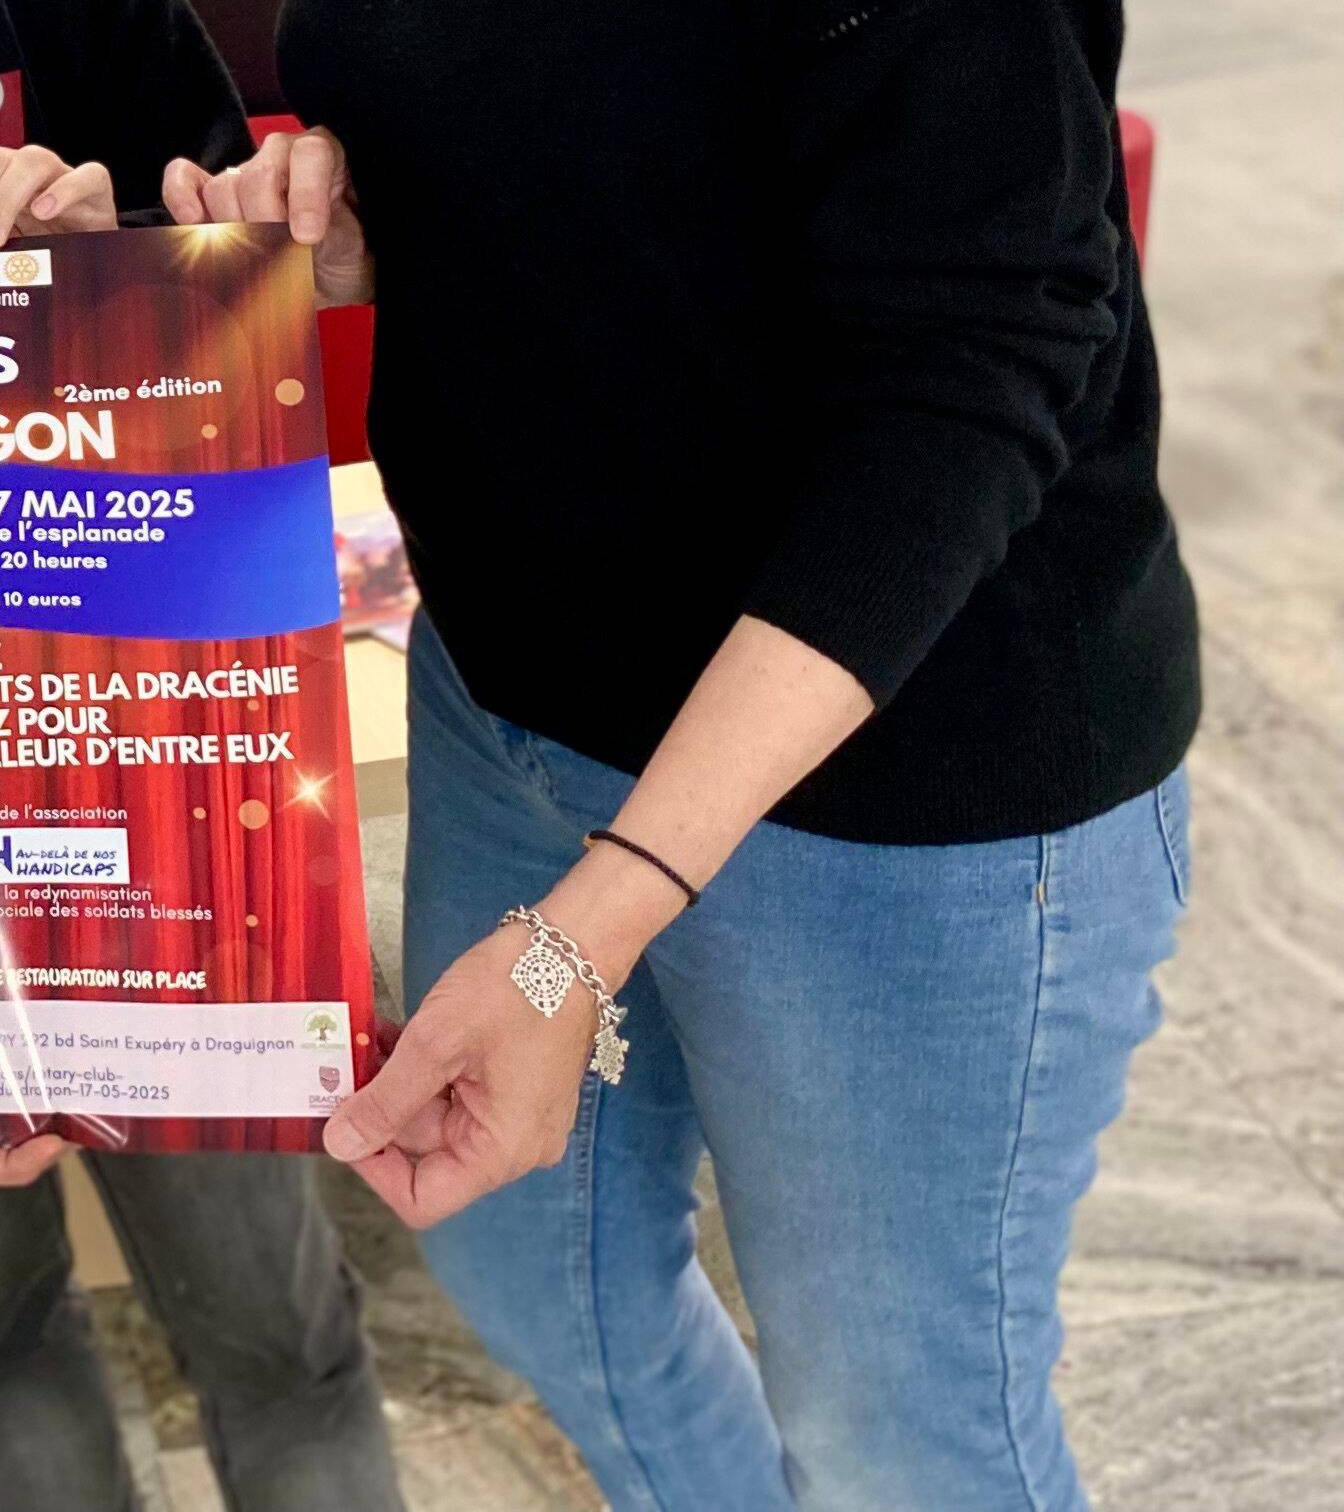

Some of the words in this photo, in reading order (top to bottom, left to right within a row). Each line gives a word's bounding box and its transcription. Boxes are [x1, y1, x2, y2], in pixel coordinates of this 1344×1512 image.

[64, 383, 130, 404] 2ème
[136, 376, 222, 399] édition
[22, 491, 95, 518] MAI
[105, 489, 194, 518] 2025
[0, 552, 28, 570] 20
[33, 551, 107, 569] heures
[3, 592, 22, 607] 10
[28, 593, 82, 607] euros
[41, 673, 82, 701] DE
[89, 672, 131, 700] LA
[137, 661, 299, 700] DRACÉNIE
[17, 706, 112, 735] POUR
[227, 732, 295, 763] EUX
[0, 805, 19, 820] de
[75, 849, 88, 859] DE
[93, 850, 116, 858] NOS
[17, 863, 117, 876] HANDICAPS
[5, 886, 19, 900] la
[24, 884, 151, 904] redynamisation
[49, 903, 78, 918] des
[84, 903, 145, 919] soldats
[150, 903, 212, 920] blessés
[122, 970, 153, 988] SUR
[157, 971, 206, 989] PLACE
[55, 1034, 74, 1048] bd
[80, 1034, 118, 1049] Saint
[125, 1037, 185, 1052] Exupéry
[191, 1038, 200, 1050] à
[206, 1038, 294, 1054] Draguignan
